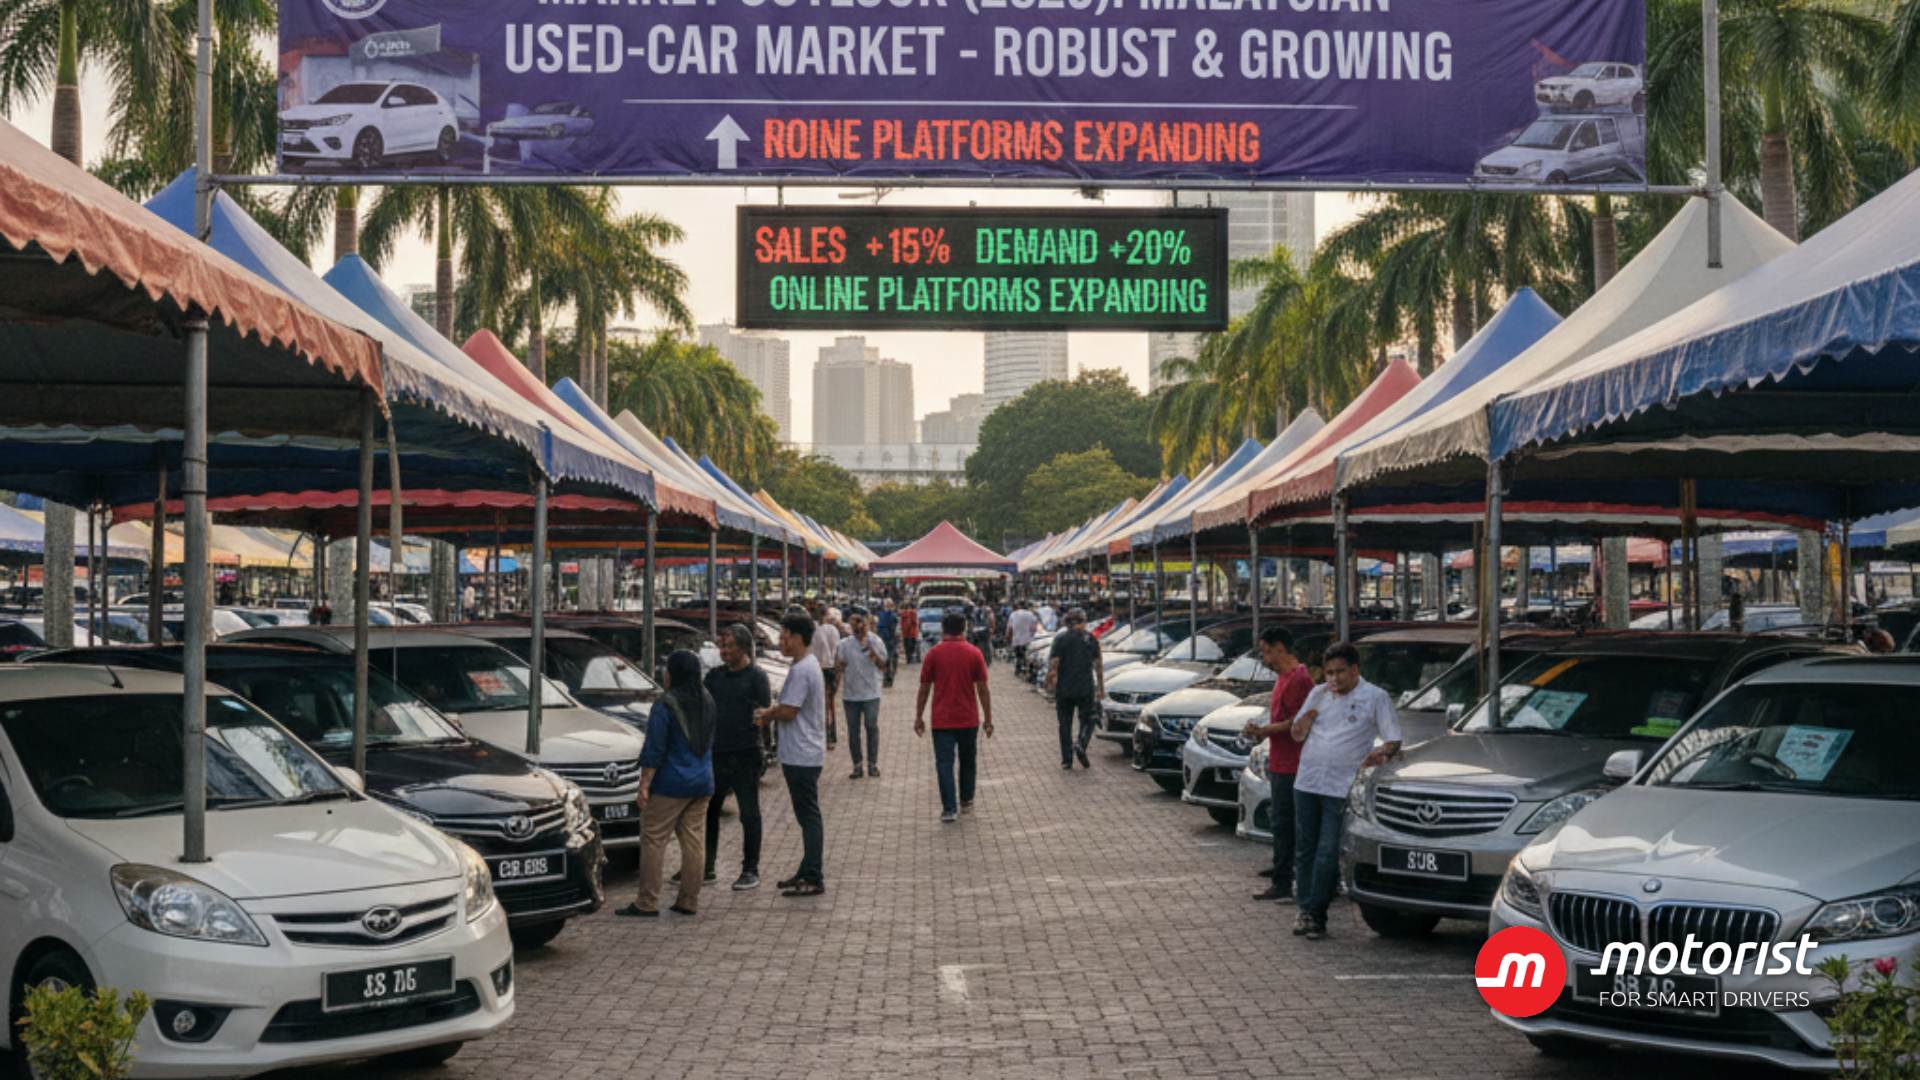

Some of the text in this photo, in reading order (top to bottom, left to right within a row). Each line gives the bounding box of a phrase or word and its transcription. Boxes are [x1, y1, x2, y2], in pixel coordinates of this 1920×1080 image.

[505, 23, 738, 75] USED-CAR
[756, 24, 946, 76] MARKET
[994, 26, 1177, 78] ROBUST
[1191, 28, 1224, 79] &
[1240, 28, 1453, 81] GROWING
[763, 118, 1260, 163] ROINE PLATFORMS EXPANDING
[754, 225, 1192, 266] SALES +15% DEMAND +20%
[769, 274, 1207, 314] ONLINE PLATFORMS EXPANDING
